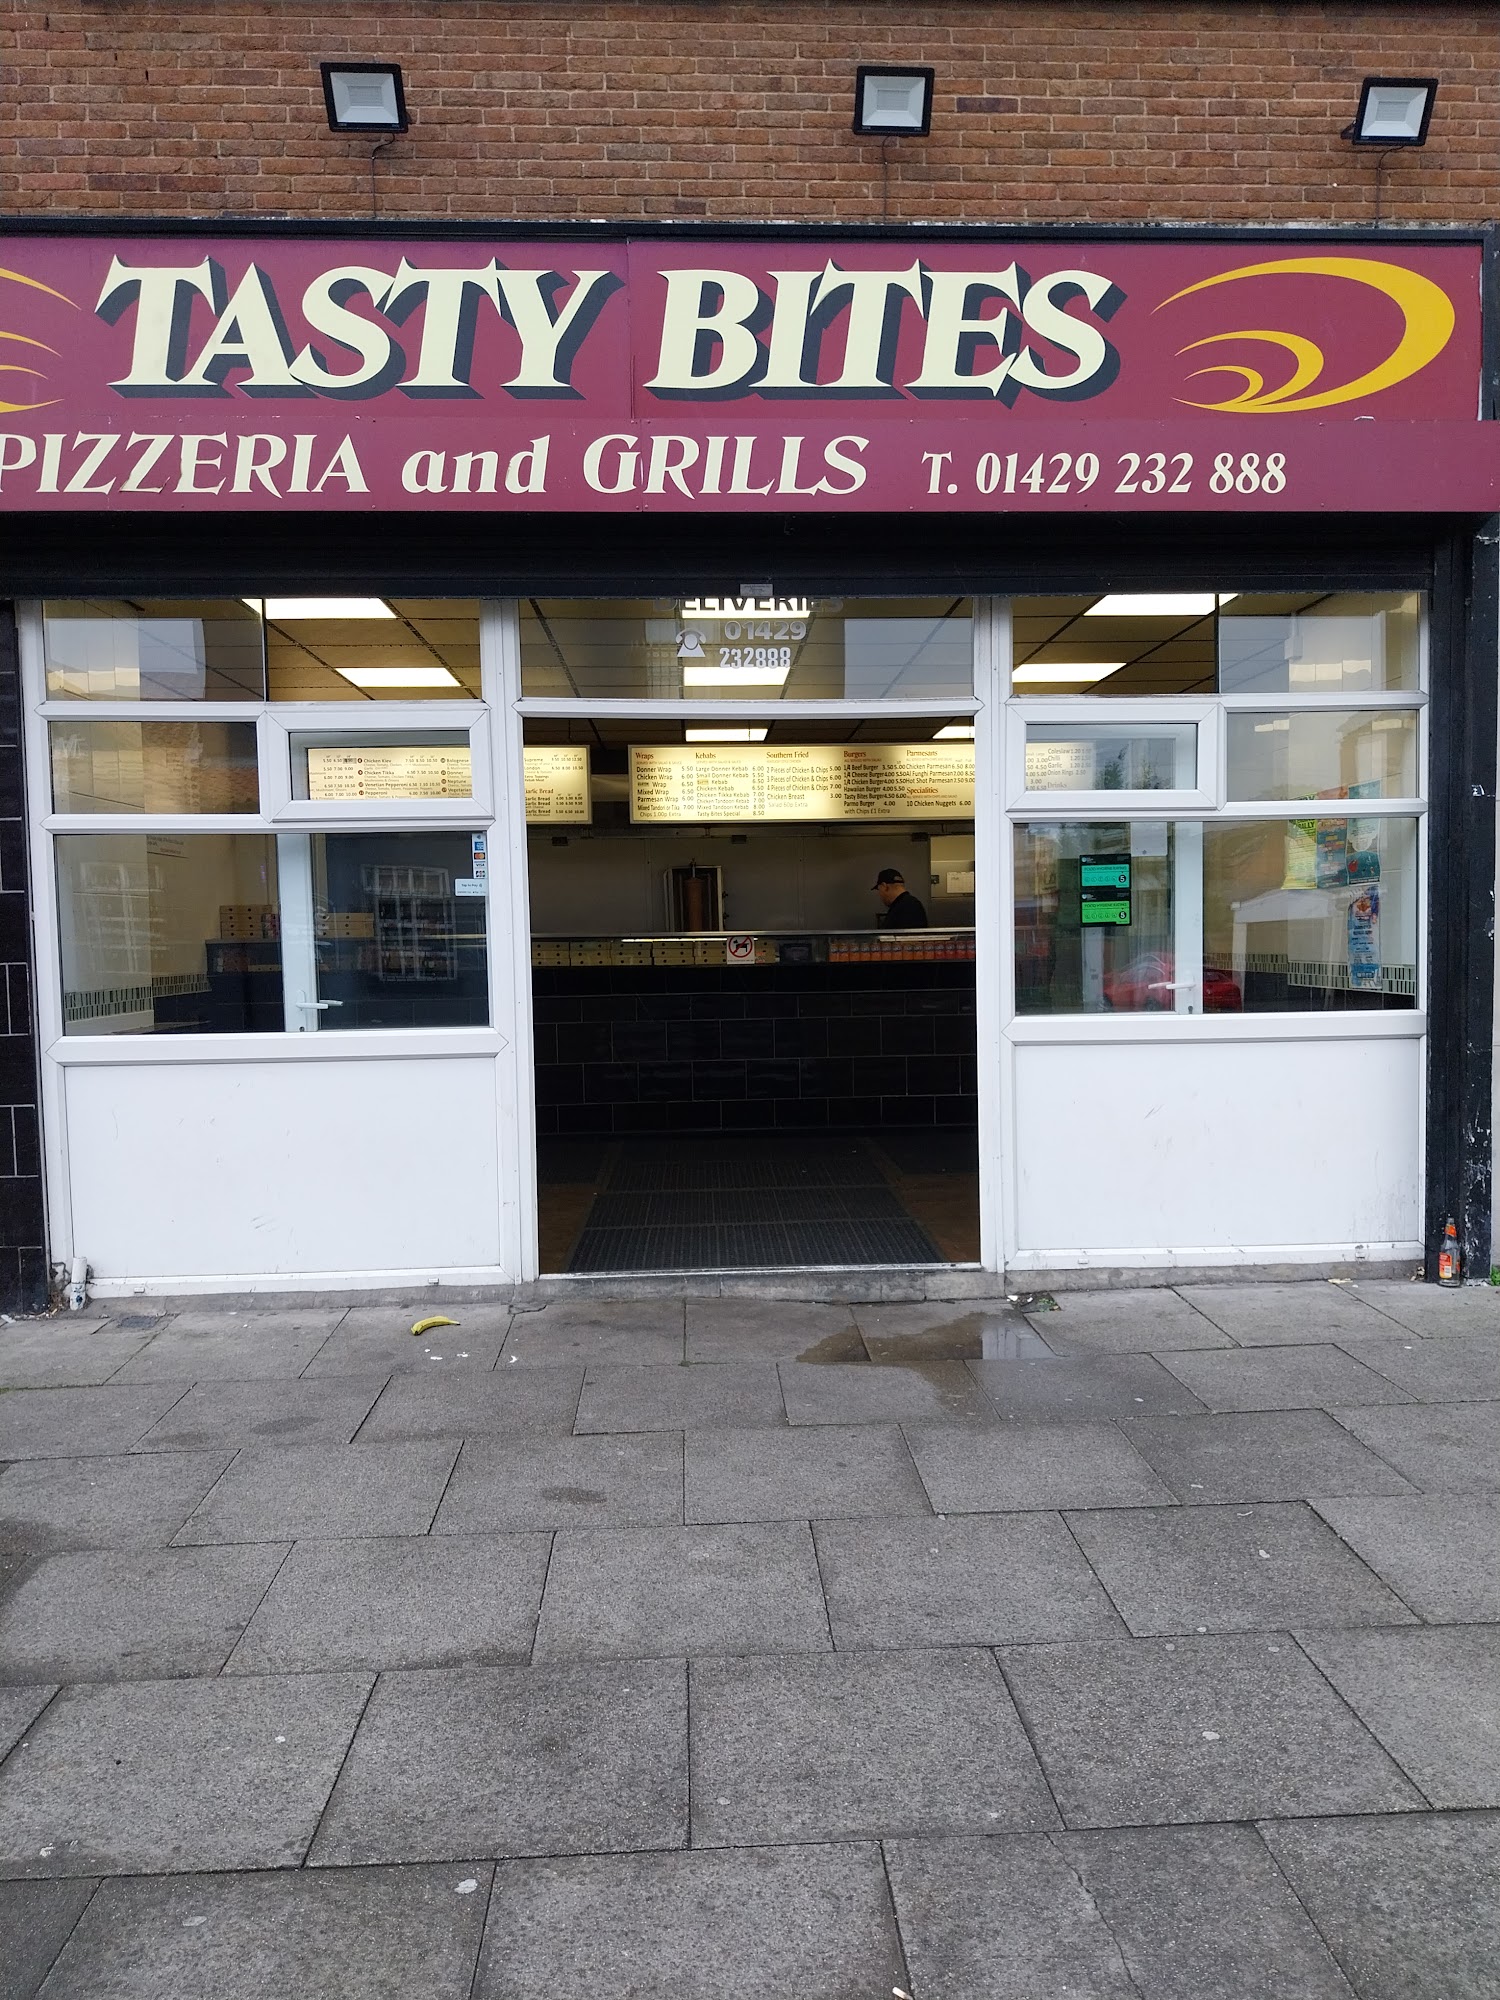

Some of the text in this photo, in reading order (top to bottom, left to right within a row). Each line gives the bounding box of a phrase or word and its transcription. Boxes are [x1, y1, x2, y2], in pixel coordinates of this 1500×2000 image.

[95, 254, 1122, 404] TASTY BITES
[0, 431, 869, 500] PIZZERIA and GRILLS
[922, 451, 1287, 497] T. 01429 232 888
[724, 621, 807, 641] 01429
[719, 647, 791, 669] 232888
